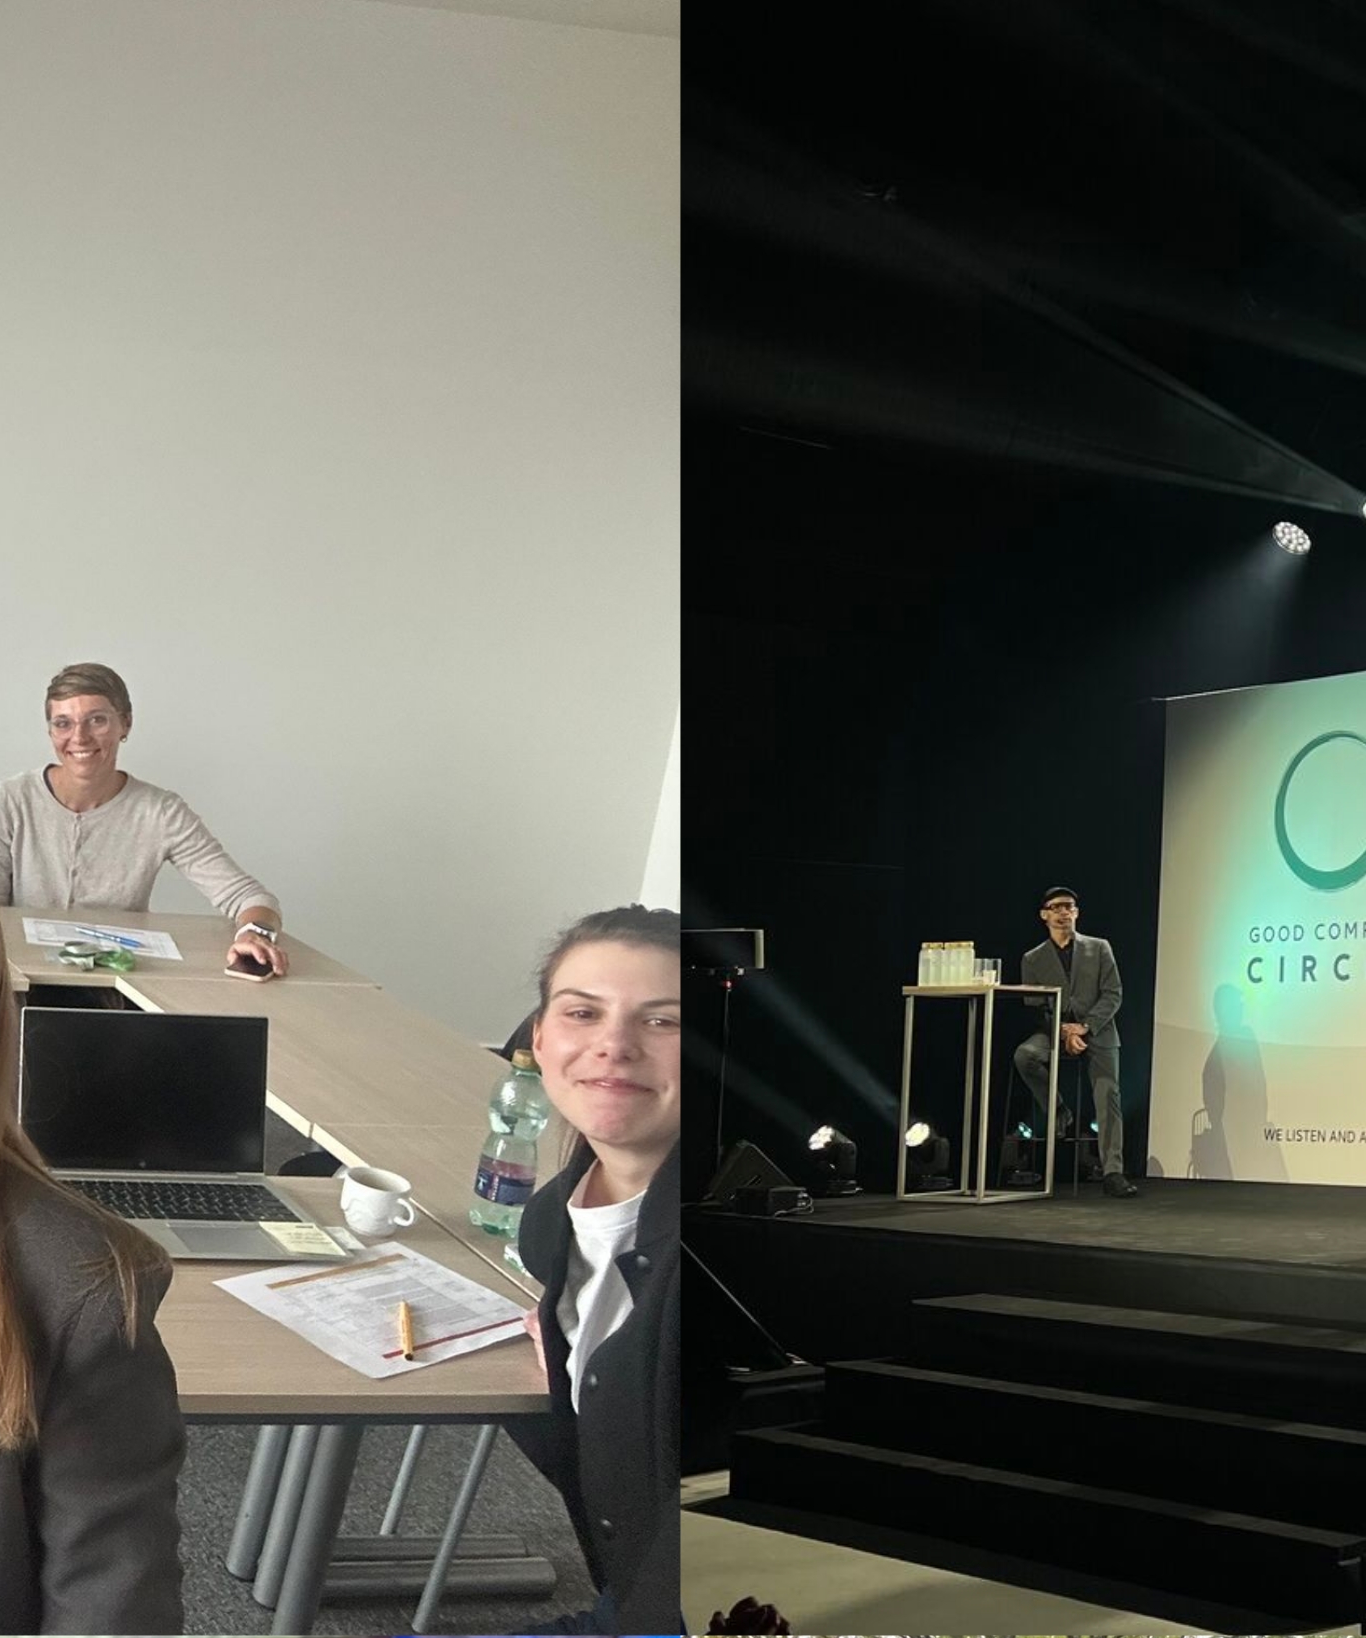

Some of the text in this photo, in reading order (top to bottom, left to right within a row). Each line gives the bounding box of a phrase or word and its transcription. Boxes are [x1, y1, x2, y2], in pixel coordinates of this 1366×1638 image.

[1249, 925, 1305, 943] GOOD
[1263, 1128, 1283, 1141] WE
[1285, 1129, 1327, 1142] LISTEN
[1329, 1130, 1356, 1143] AND
